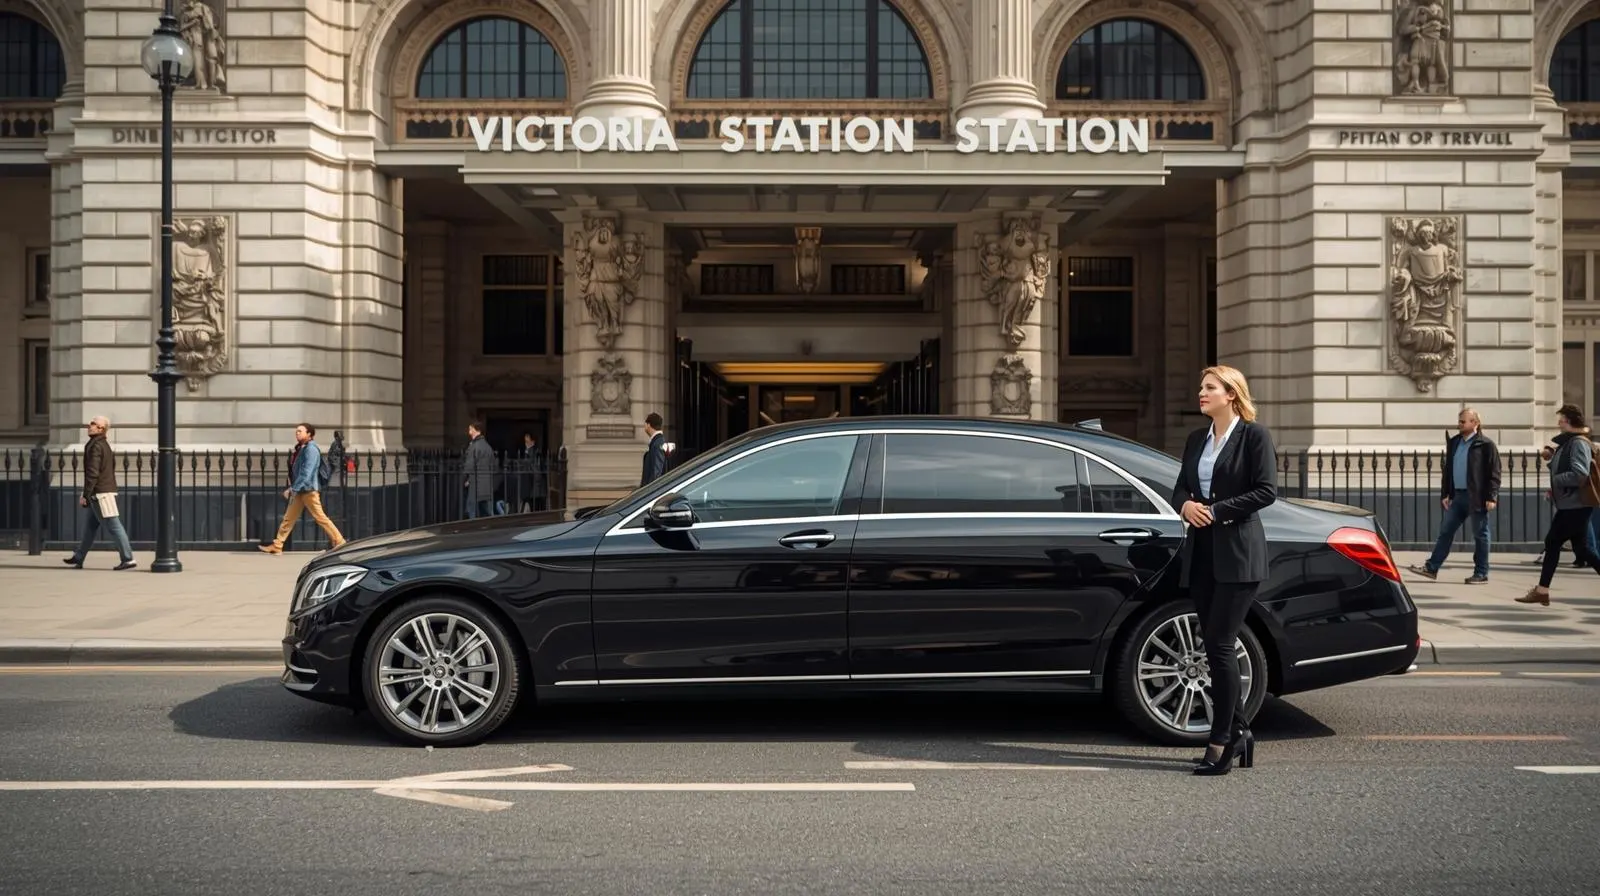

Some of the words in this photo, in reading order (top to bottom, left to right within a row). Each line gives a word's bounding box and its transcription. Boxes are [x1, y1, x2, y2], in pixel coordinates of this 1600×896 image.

[467, 116, 679, 152] VICTORIA
[720, 116, 914, 153] STATION
[955, 117, 1149, 153] STATION
